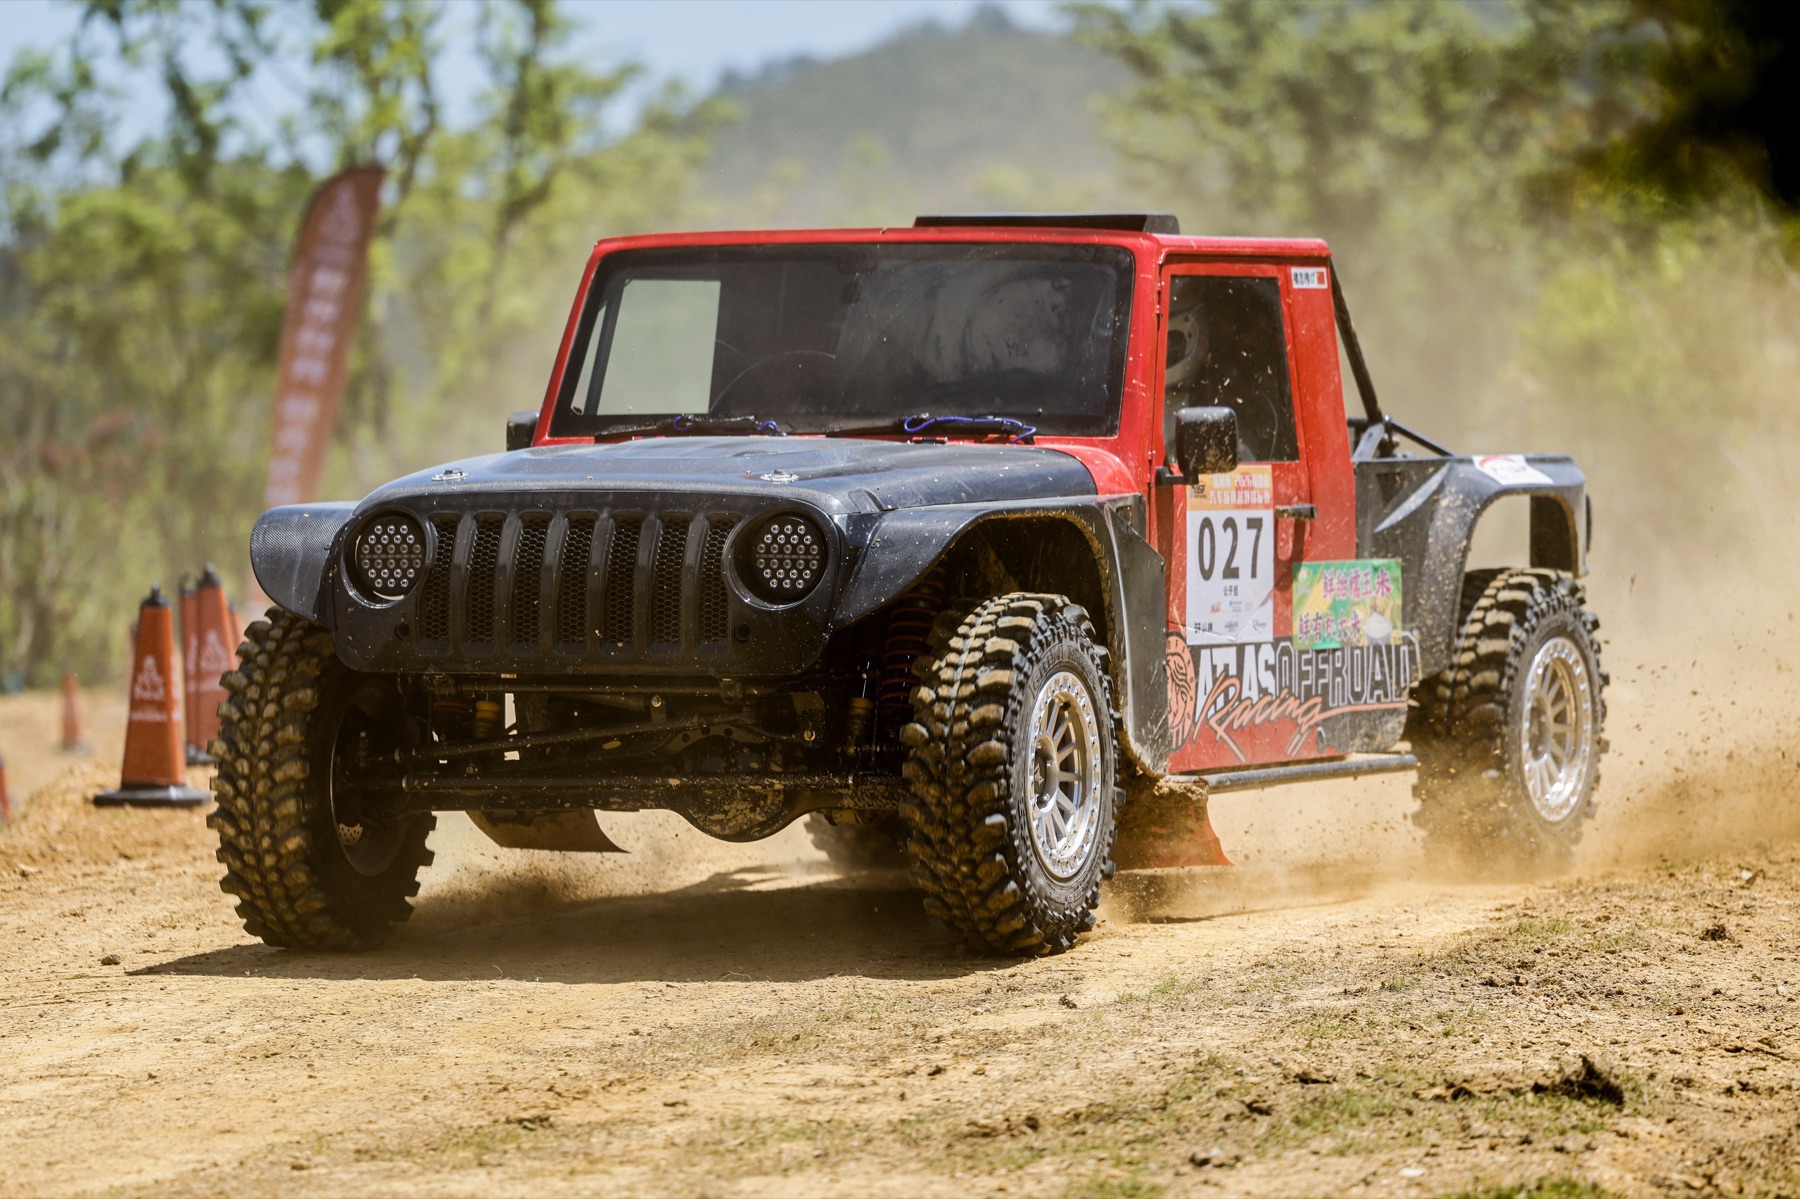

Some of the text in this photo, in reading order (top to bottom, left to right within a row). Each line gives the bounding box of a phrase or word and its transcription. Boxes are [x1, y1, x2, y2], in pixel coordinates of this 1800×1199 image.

[1198, 516, 1264, 582] 027
[1322, 566, 1393, 600] 鲜甜糯玉米
